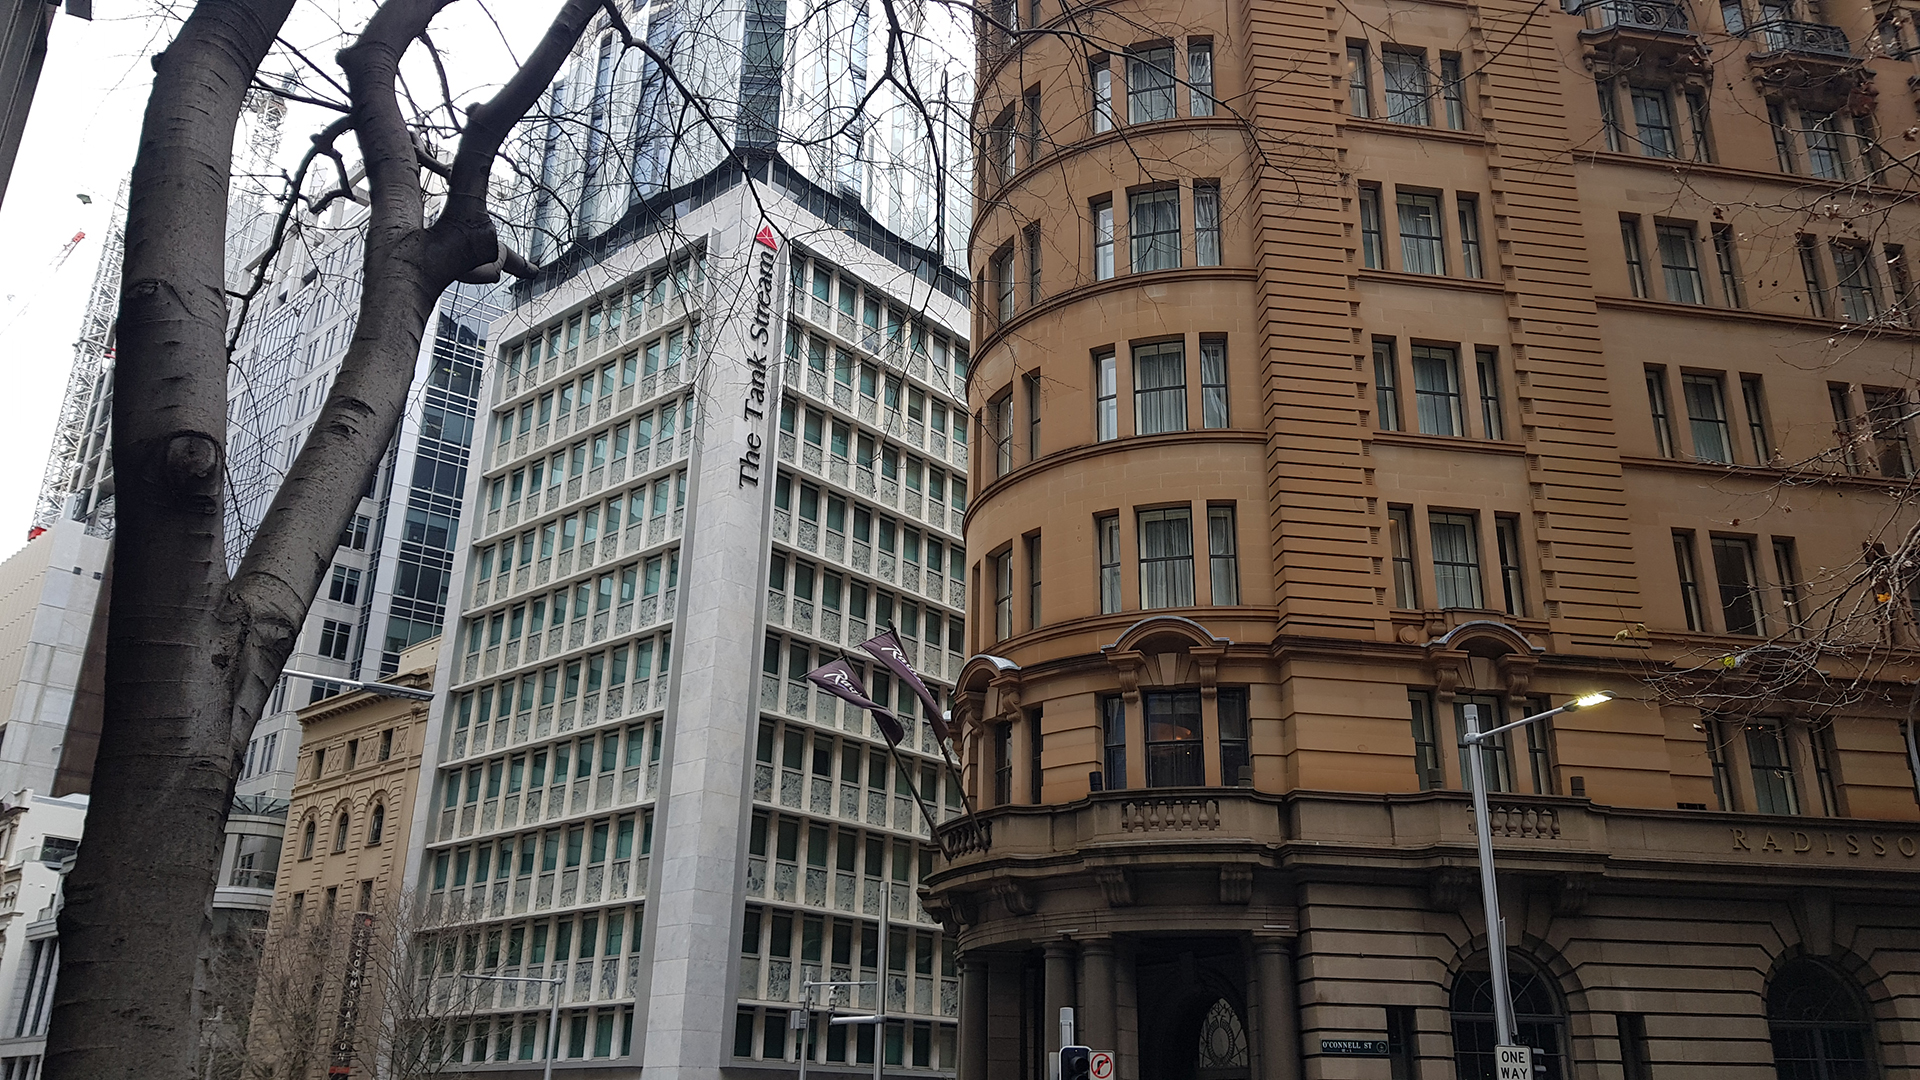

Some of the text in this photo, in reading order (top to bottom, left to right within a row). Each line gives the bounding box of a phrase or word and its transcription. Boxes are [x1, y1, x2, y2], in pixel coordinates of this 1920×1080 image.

[739, 250, 774, 489] The Tank Stream
[1730, 828, 1917, 857] RADISSO
[1322, 1041, 1361, 1049] O'CONNELL
[1501, 1050, 1526, 1063] ONE
[1500, 1067, 1528, 1079] WAY
